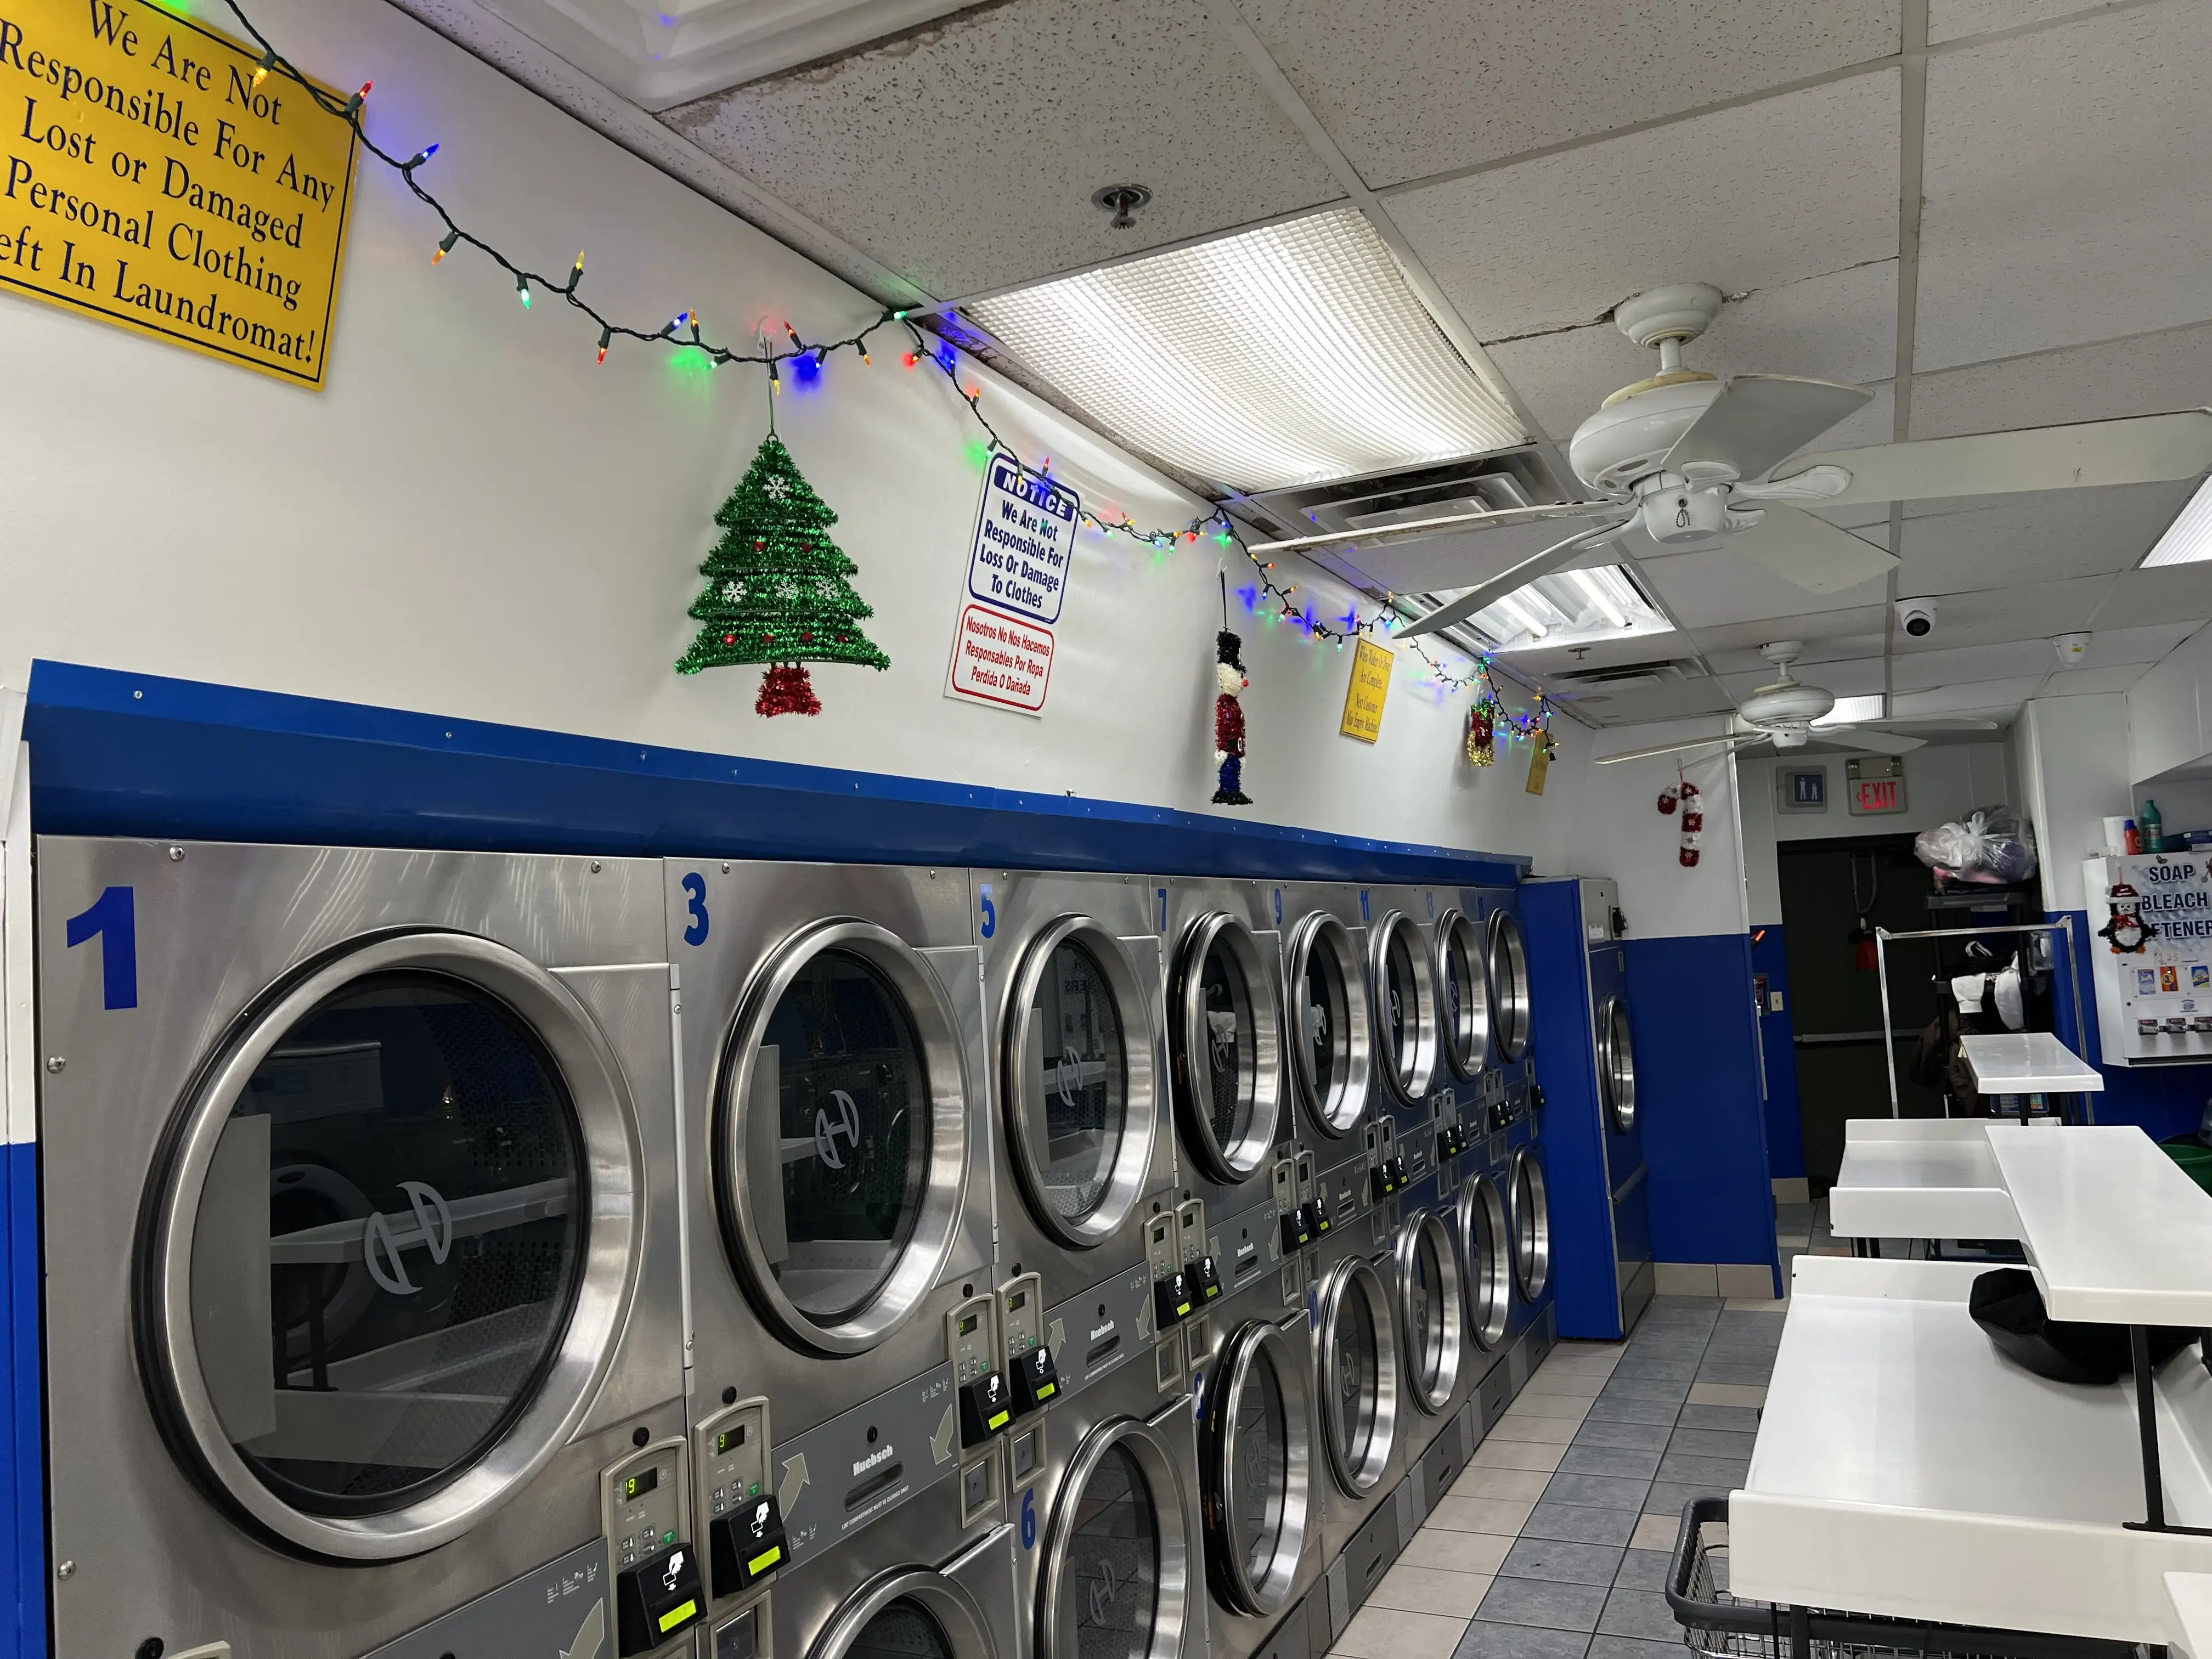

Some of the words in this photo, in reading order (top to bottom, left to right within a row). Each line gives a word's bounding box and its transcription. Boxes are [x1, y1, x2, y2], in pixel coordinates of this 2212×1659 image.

[89, 0, 138, 57] We
[151, 35, 211, 92] Are
[225, 65, 282, 125] Not
[0, 19, 199, 146] Responsible
[213, 119, 265, 173] For
[275, 154, 335, 212] Any
[21, 96, 97, 163] Lost
[111, 151, 147, 183] or
[161, 156, 302, 248] Damaged
[4, 155, 153, 250] Personal
[168, 223, 302, 311] Clothing
[0, 225, 43, 272] eft
[59, 240, 96, 291] In
[112, 259, 315, 363] Laundromat!
[1002, 473, 1067, 517] NOTICE
[1001, 499, 1018, 523] We
[1019, 510, 1037, 533] Are
[1040, 521, 1058, 541] Not
[984, 520, 1045, 562] Responsible
[1047, 549, 1064, 568] For
[979, 544, 1003, 569] Loss
[1006, 556, 1019, 574] Or
[1020, 562, 1059, 592] Damage
[991, 574, 1002, 594] To
[1006, 579, 1043, 608] Clothes
[965, 639, 1013, 668] Responsables
[1015, 655, 1026, 670] Por
[1027, 659, 1043, 678] Ropa
[966, 616, 996, 640] Nosotros
[997, 627, 1007, 642] No
[1008, 630, 1021, 648] Nos
[1022, 634, 1049, 657] Hacemos
[971, 665, 998, 689] Perdida
[999, 675, 1005, 689] O
[1006, 677, 1030, 696] Dañada
[1861, 782, 1897, 810] EXIT
[2149, 865, 2193, 882] SOAP
[682, 872, 709, 946] 3
[980, 884, 995, 938] 5
[1158, 888, 1167, 932] 7
[1274, 888, 1282, 926] 9
[1361, 890, 1369, 921] 11
[2142, 891, 2208, 910] BLEACH
[66, 886, 138, 1011] 1
[2151, 920, 2212, 938] FTENER
[853, 1444, 894, 1476] Huebsch
[1021, 1488, 1036, 1550] 6
